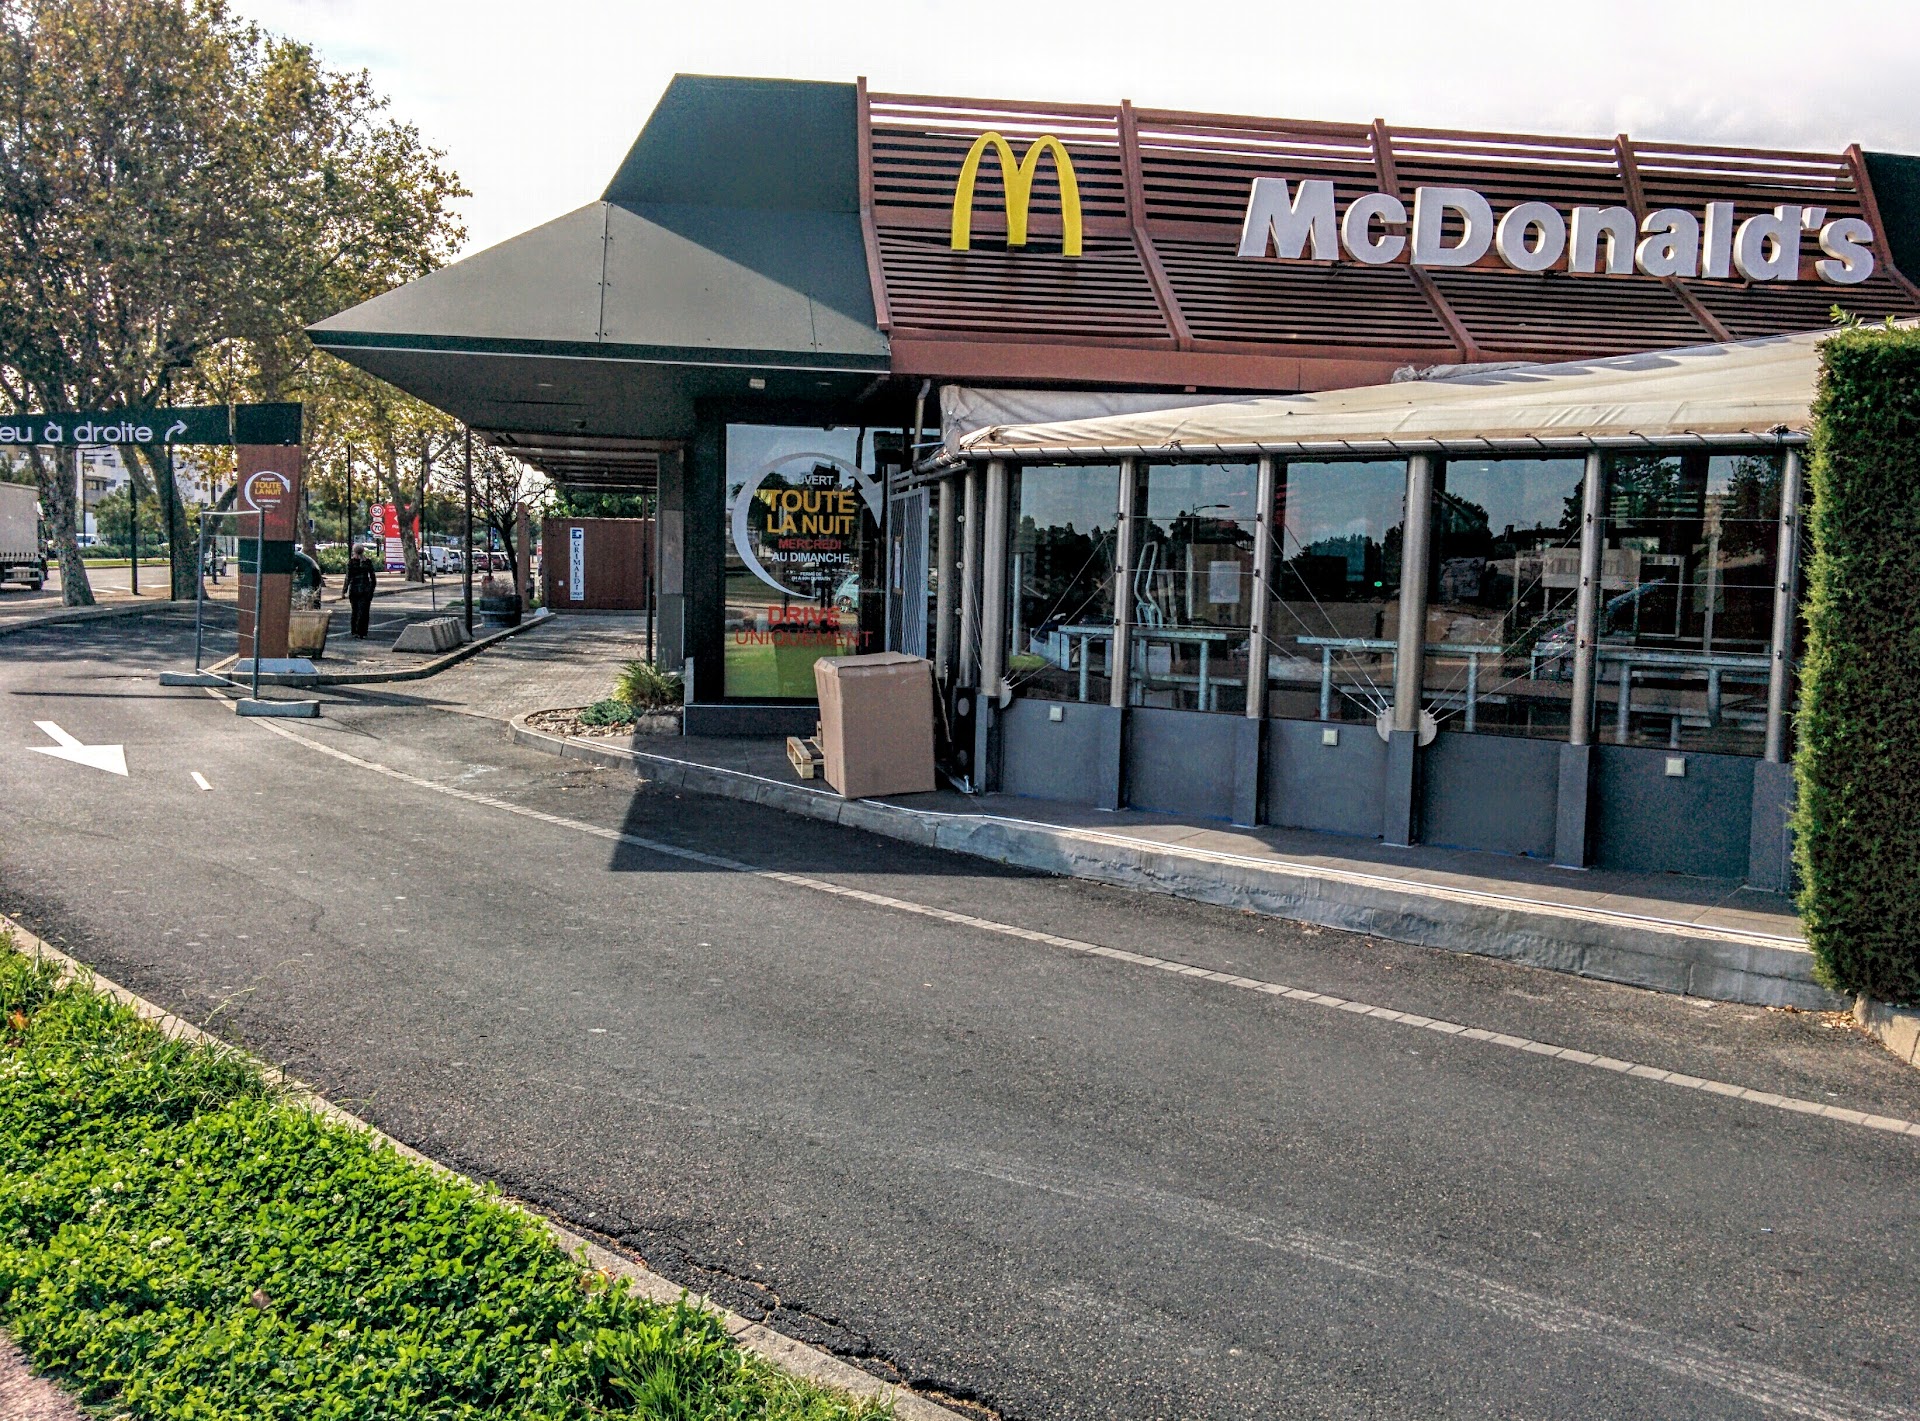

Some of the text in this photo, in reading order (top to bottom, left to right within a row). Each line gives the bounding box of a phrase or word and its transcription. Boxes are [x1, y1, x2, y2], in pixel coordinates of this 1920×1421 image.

[1237, 176, 1875, 285] McDonald's
[0, 420, 153, 443] eu à droite
[254, 481, 281, 489] TOUTE
[768, 489, 855, 513] TOUTE
[767, 514, 855, 535] LA NUIT
[778, 538, 842, 550] MERCREDI
[573, 540, 581, 591] GRIMALDI
[771, 552, 850, 564] AU DIMANCHE
[767, 605, 841, 627] DRIVE
[735, 629, 874, 648] UNIQUEMENT
